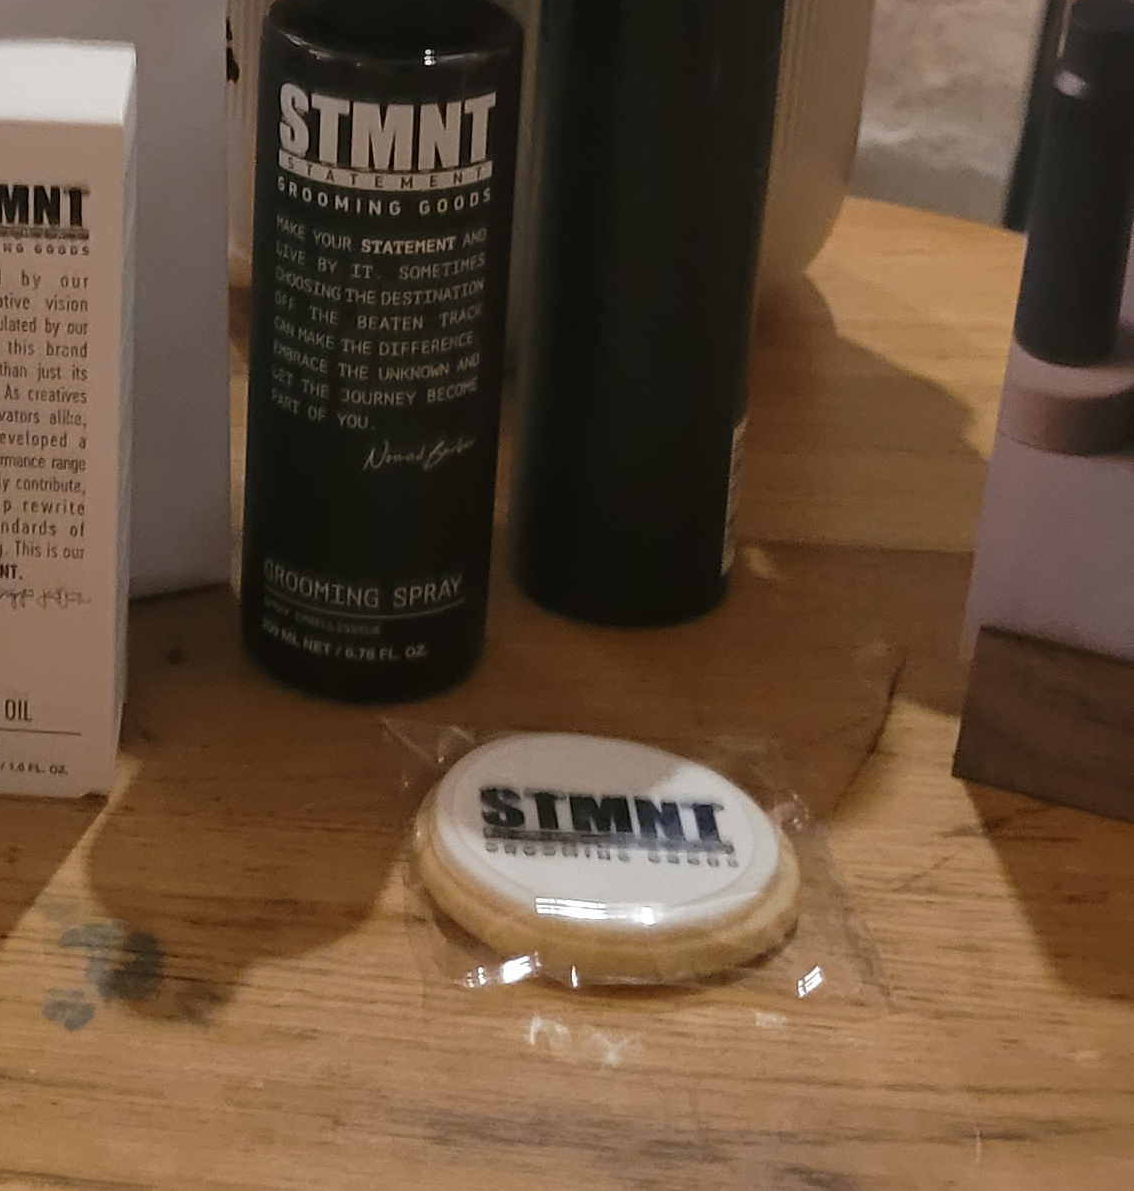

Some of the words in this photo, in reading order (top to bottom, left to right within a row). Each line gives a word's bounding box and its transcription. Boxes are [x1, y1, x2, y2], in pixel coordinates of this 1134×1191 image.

[279, 82, 496, 171] STMNT
[285, 155, 485, 190] STATEMENT
[277, 176, 401, 216] GROOMING
[418, 187, 492, 215] GOODS
[276, 214, 306, 240] MAKE
[312, 229, 352, 252] YOUR
[361, 236, 456, 255] STATEMENT
[462, 227, 487, 248] AND
[34, 243, 91, 256] GOODS
[275, 240, 306, 266] LIVE
[318, 256, 339, 274] BY
[399, 251, 485, 281] SOMETIMES
[21, 270, 41, 291] by
[60, 274, 90, 289] our
[345, 287, 376, 304] THE
[381, 278, 485, 306] DESTINATION
[45, 295, 89, 312] vision
[44, 318, 61, 338] by
[67, 321, 89, 336] our
[309, 305, 339, 326] THE
[357, 314, 424, 331] BEATEN
[439, 302, 484, 328] TRACK
[273, 315, 295, 338] CAN
[298, 326, 335, 351] MAKE
[341, 337, 373, 356] THE
[8, 339, 36, 356] this
[46, 341, 88, 359] brand
[273, 340, 328, 374] EMBRACE
[337, 362, 370, 380] THE
[378, 361, 450, 382] UNKNOWN
[455, 353, 481, 374] AND
[0, 361, 28, 378] than
[37, 364, 62, 382] just
[72, 364, 88, 382] its
[4, 384, 20, 401] As
[27, 386, 88, 405] creatives
[272, 365, 294, 387] LET
[301, 378, 330, 400] THE
[341, 388, 418, 407] JOURNEY
[427, 376, 479, 404] BECOME
[49, 410, 88, 429] alike,
[271, 388, 301, 415] PART
[307, 405, 328, 422] OF
[336, 412, 376, 431] YOU.
[78, 436, 87, 450] a
[51, 456, 87, 475] range
[15, 475, 87, 497] contribute,
[22, 497, 86, 517] rewrite
[69, 522, 86, 538] of
[15, 540, 42, 558] This
[47, 542, 59, 559] is
[62, 547, 86, 560] our
[263, 558, 380, 609] GROOMING
[393, 573, 464, 609] SPRAY
[280, 627, 300, 648] ML
[302, 637, 332, 656] NET
[4, 698, 34, 722] OIL
[479, 787, 725, 844] STMNT
